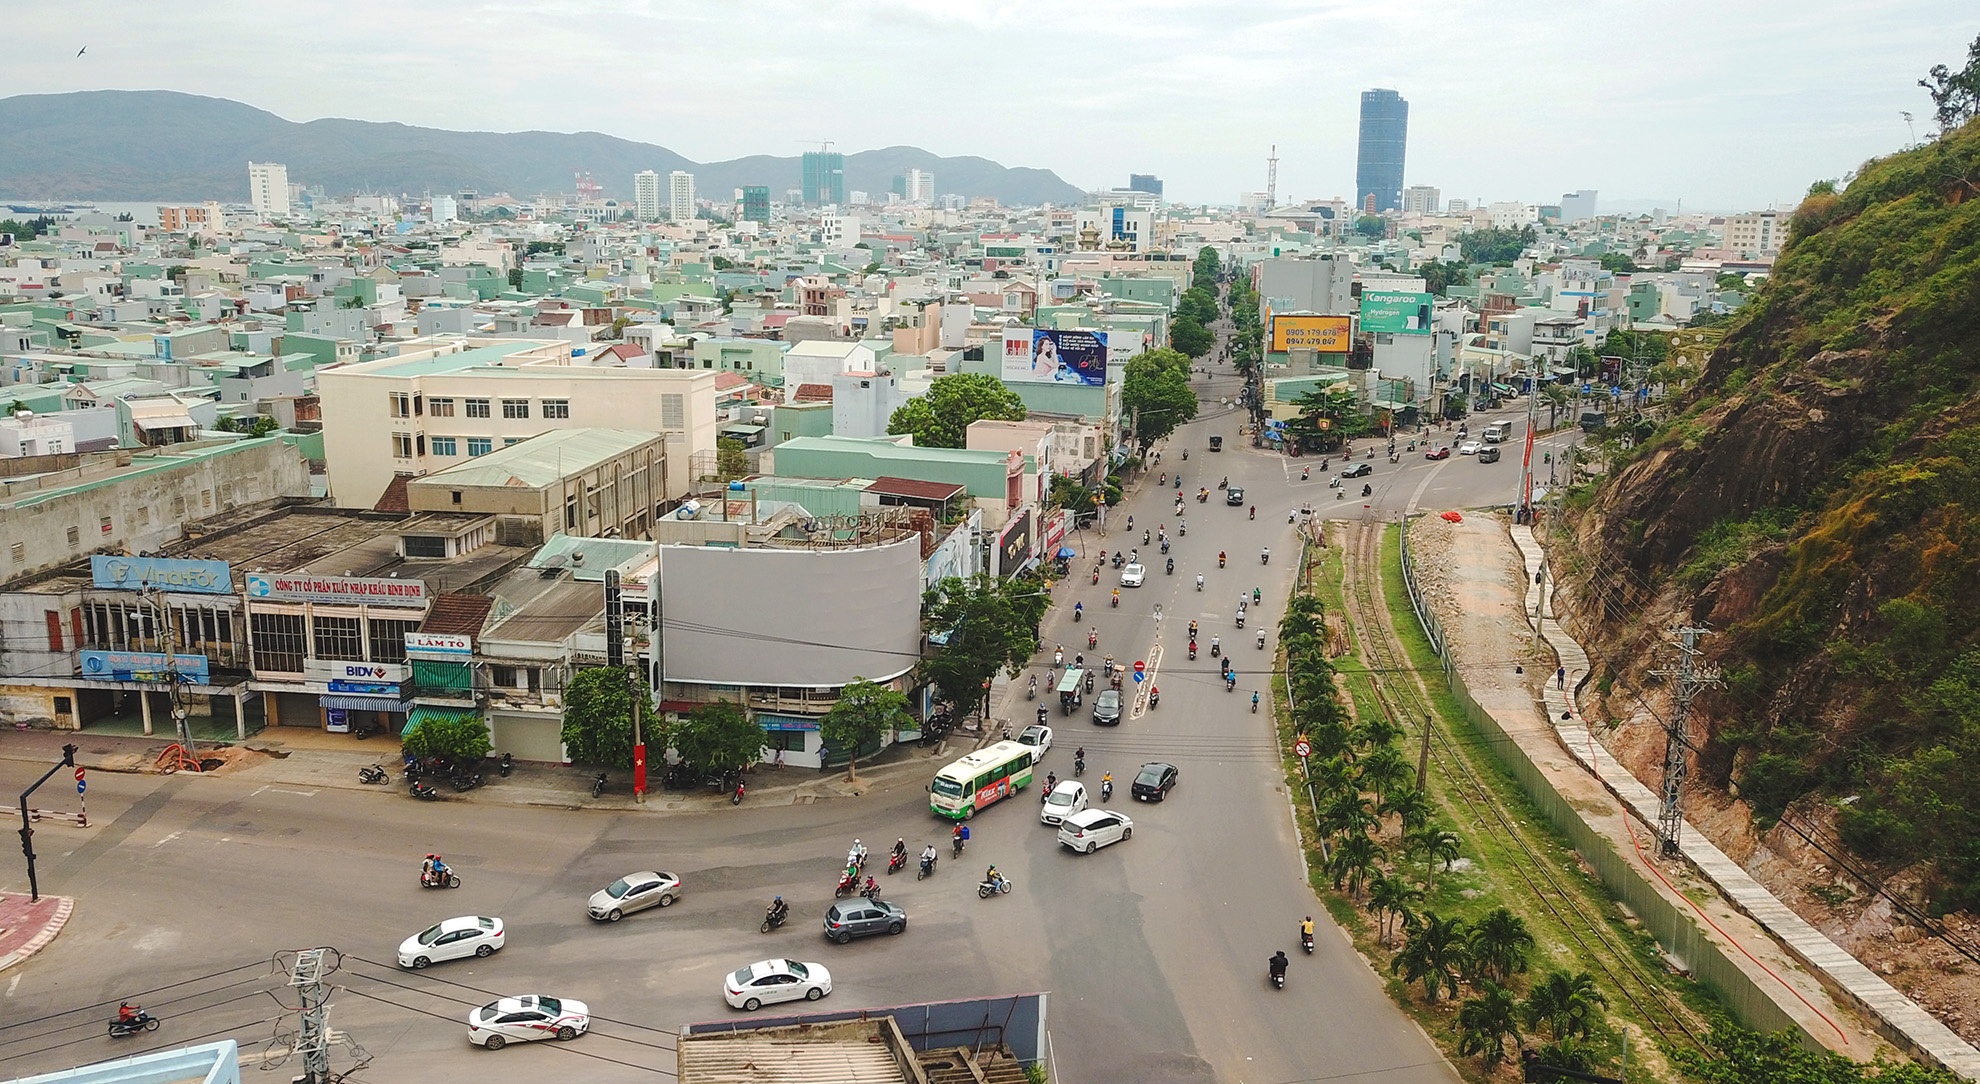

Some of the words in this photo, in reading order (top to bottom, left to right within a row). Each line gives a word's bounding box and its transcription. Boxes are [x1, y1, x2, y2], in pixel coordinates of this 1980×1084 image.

[1365, 293, 1416, 304] Kangaroo
[275, 578, 292, 592] CÔNG
[294, 581, 302, 592] TY
[346, 666, 373, 676] BIDV
